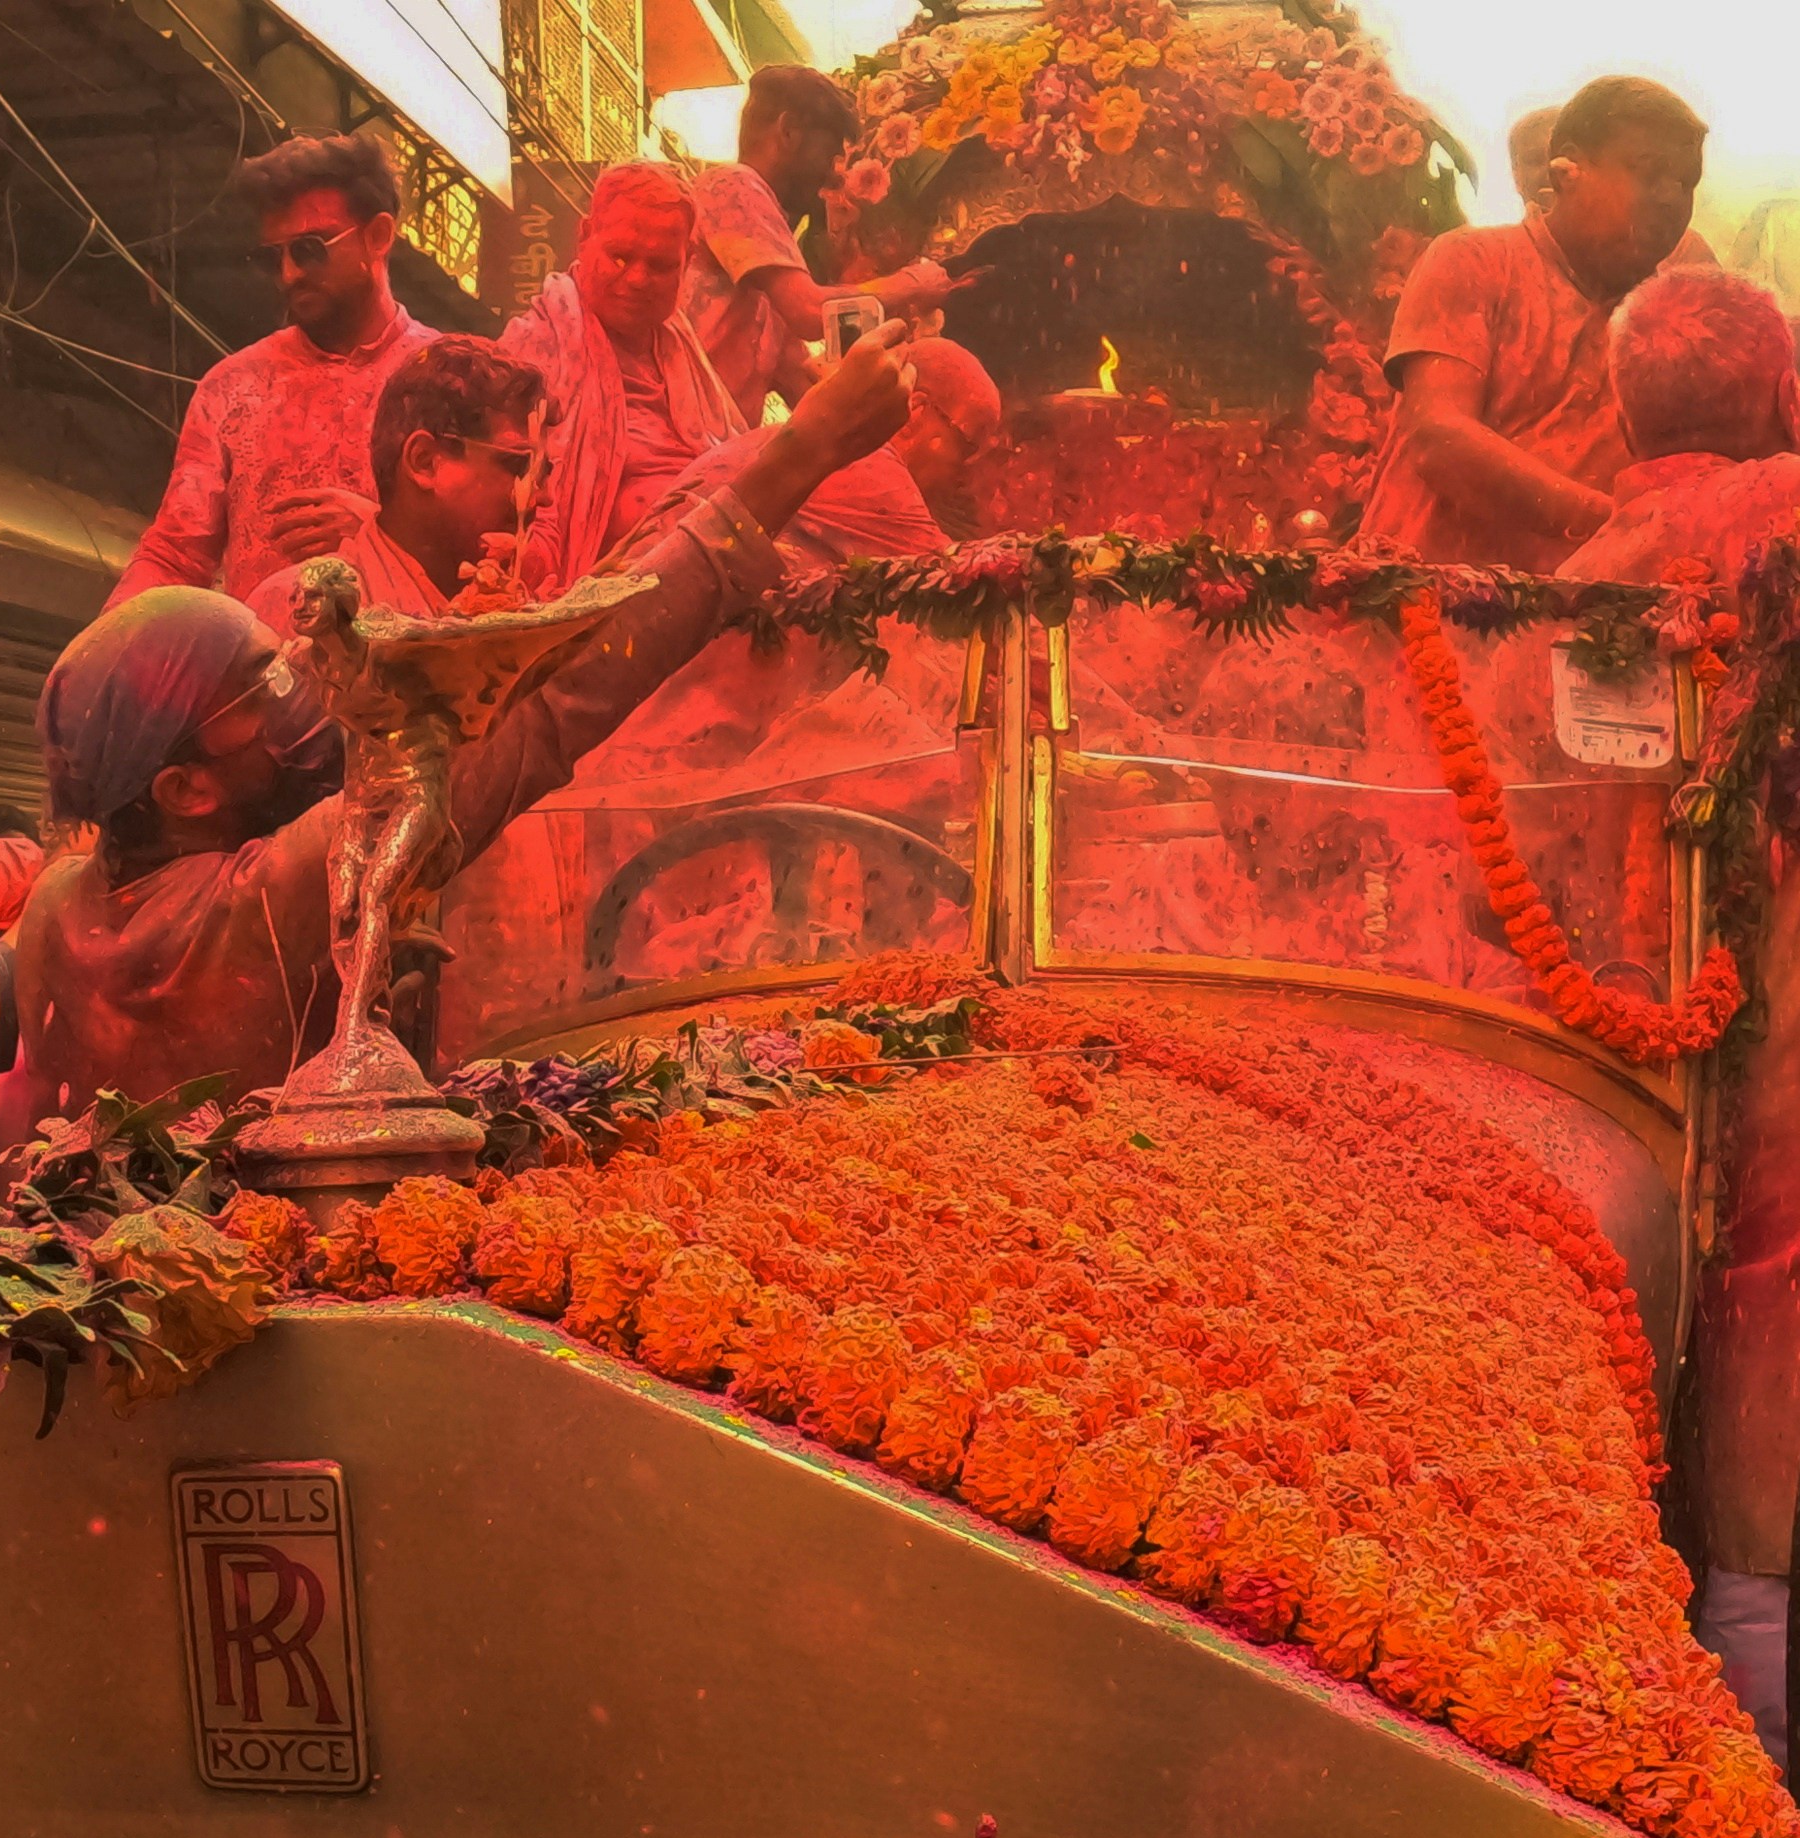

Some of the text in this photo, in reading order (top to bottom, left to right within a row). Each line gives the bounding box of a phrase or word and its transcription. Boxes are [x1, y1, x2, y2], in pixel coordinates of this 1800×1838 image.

[191, 1487, 331, 1525] ROLLS
[201, 1542, 343, 1725] RR
[210, 1737, 351, 1775] ROYCE
